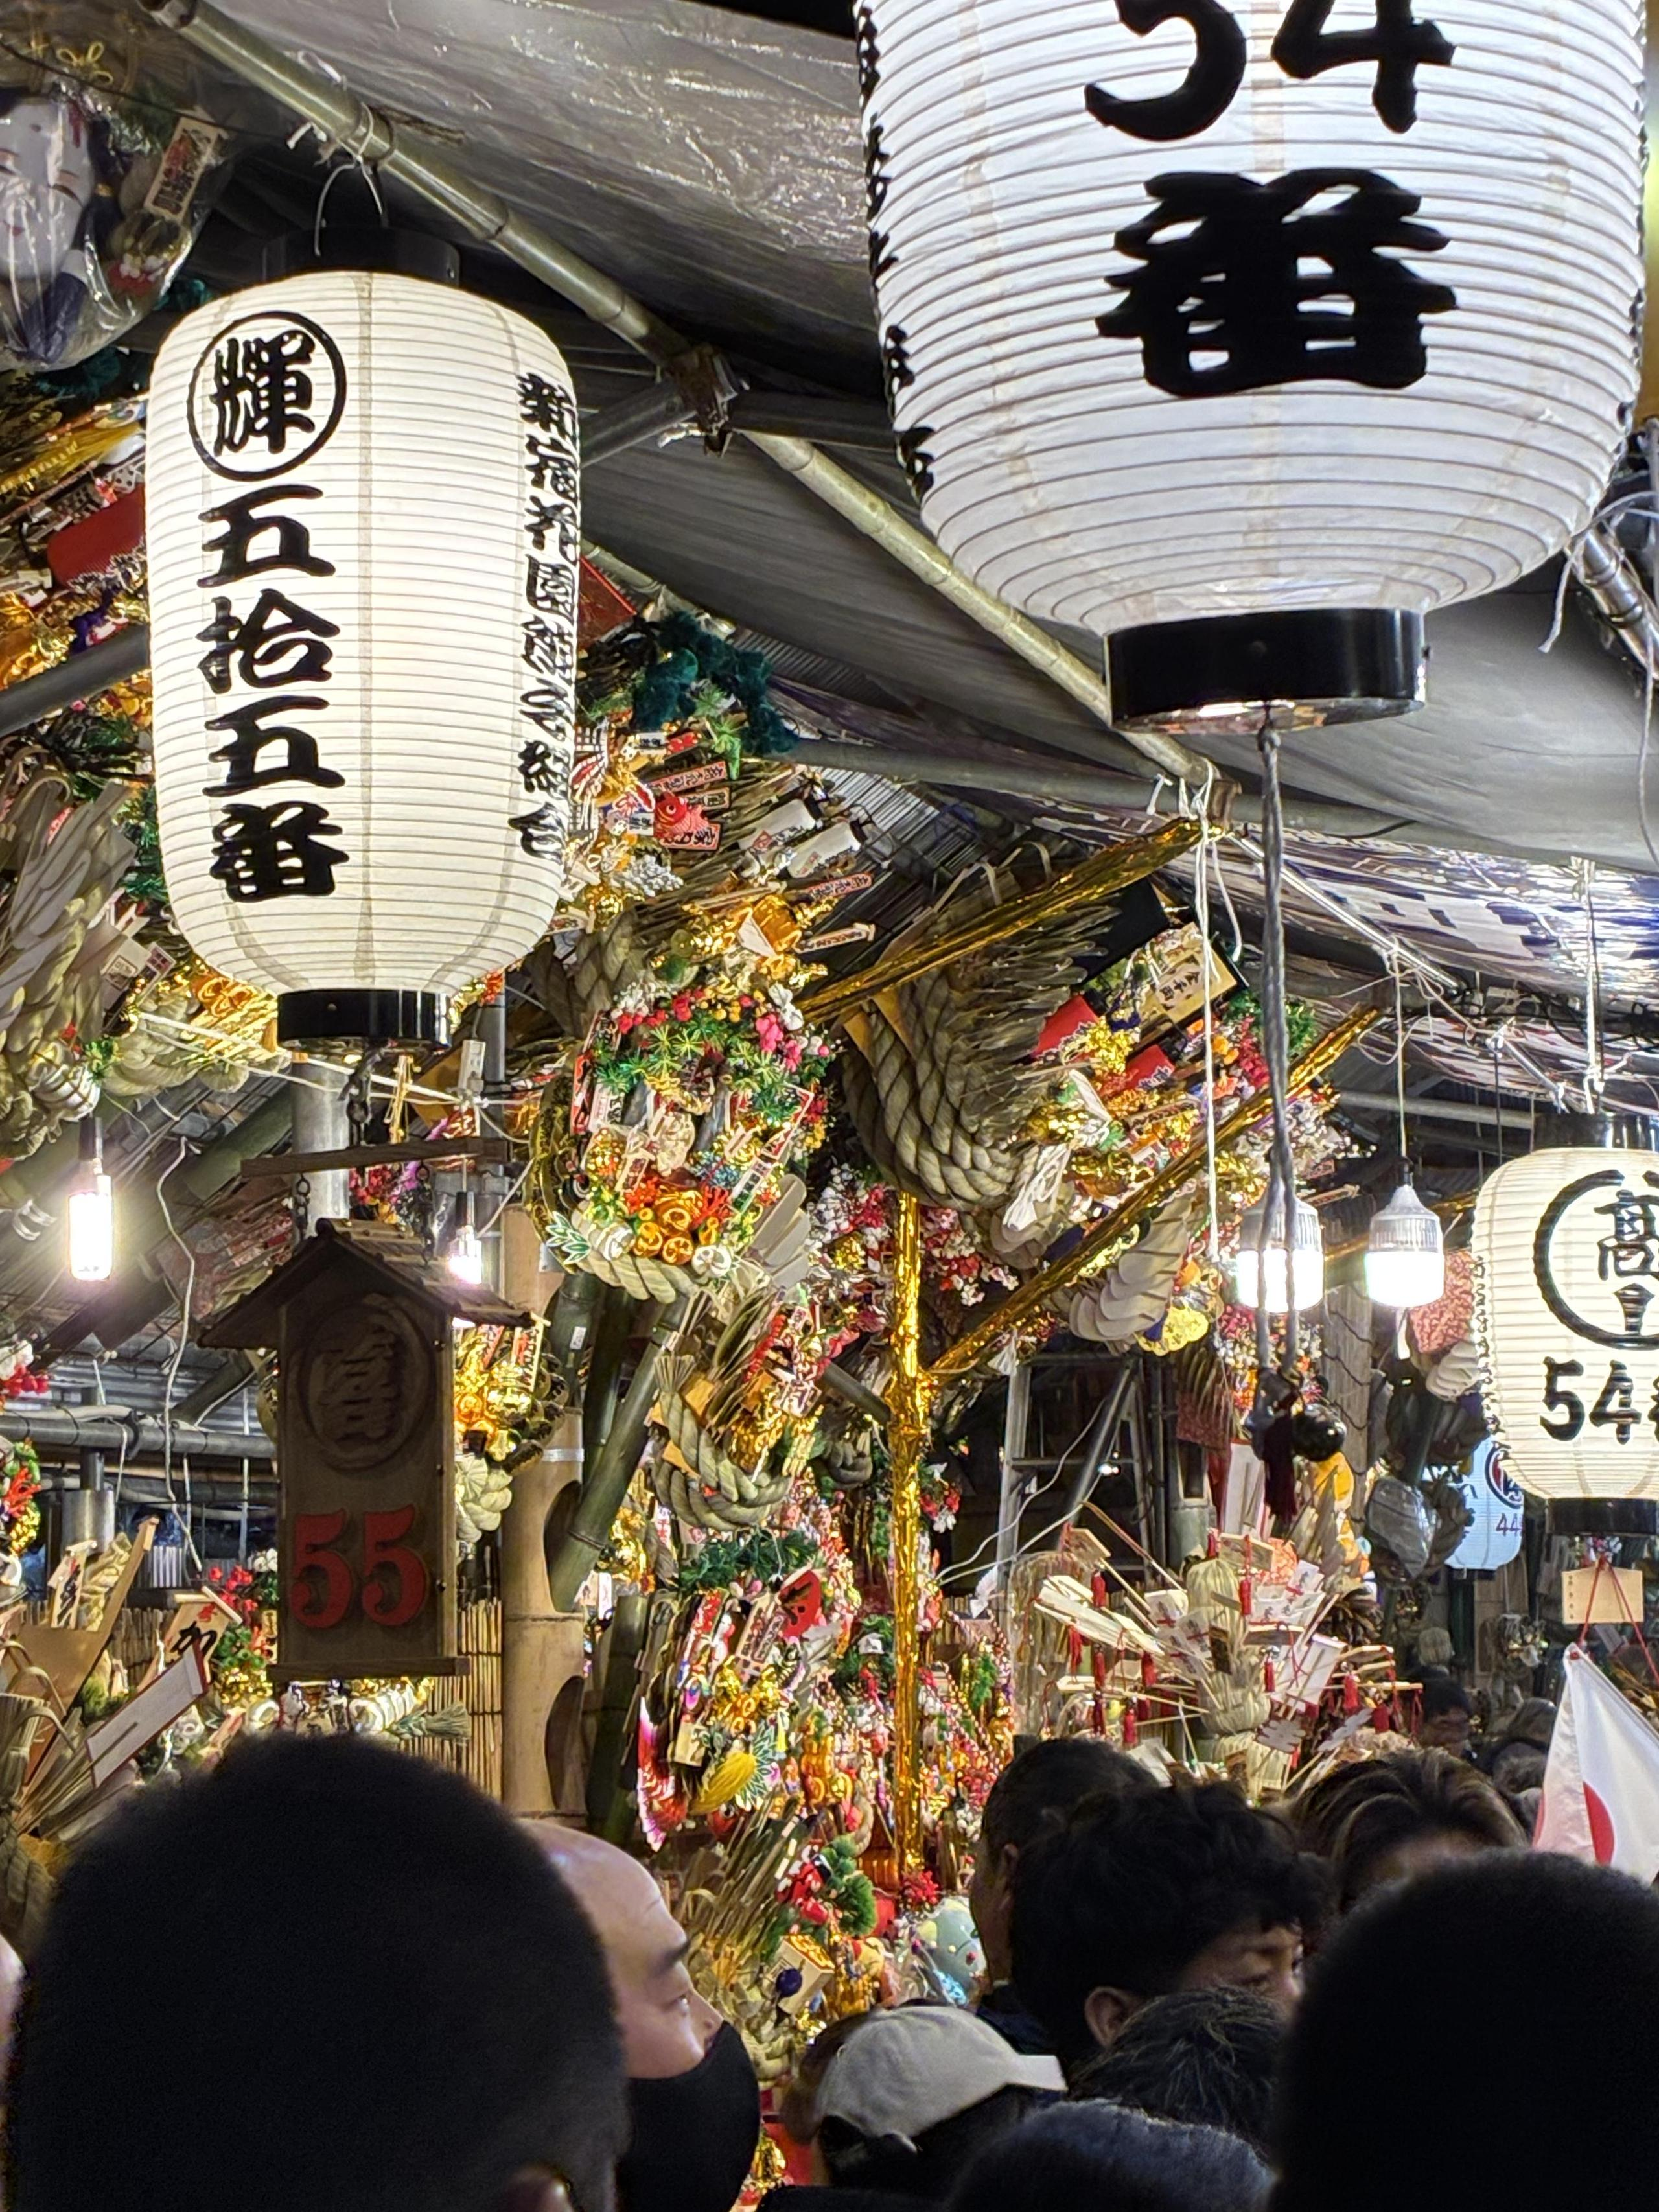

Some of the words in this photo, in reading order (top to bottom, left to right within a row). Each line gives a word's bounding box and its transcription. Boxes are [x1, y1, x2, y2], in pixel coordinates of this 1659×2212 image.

[1095, 169, 1457, 399] 番
[211, 328, 316, 456] 輝
[198, 485, 349, 902] 五拾五番
[1540, 1356, 1659, 1445] 54
[290, 1504, 428, 1629] 55
